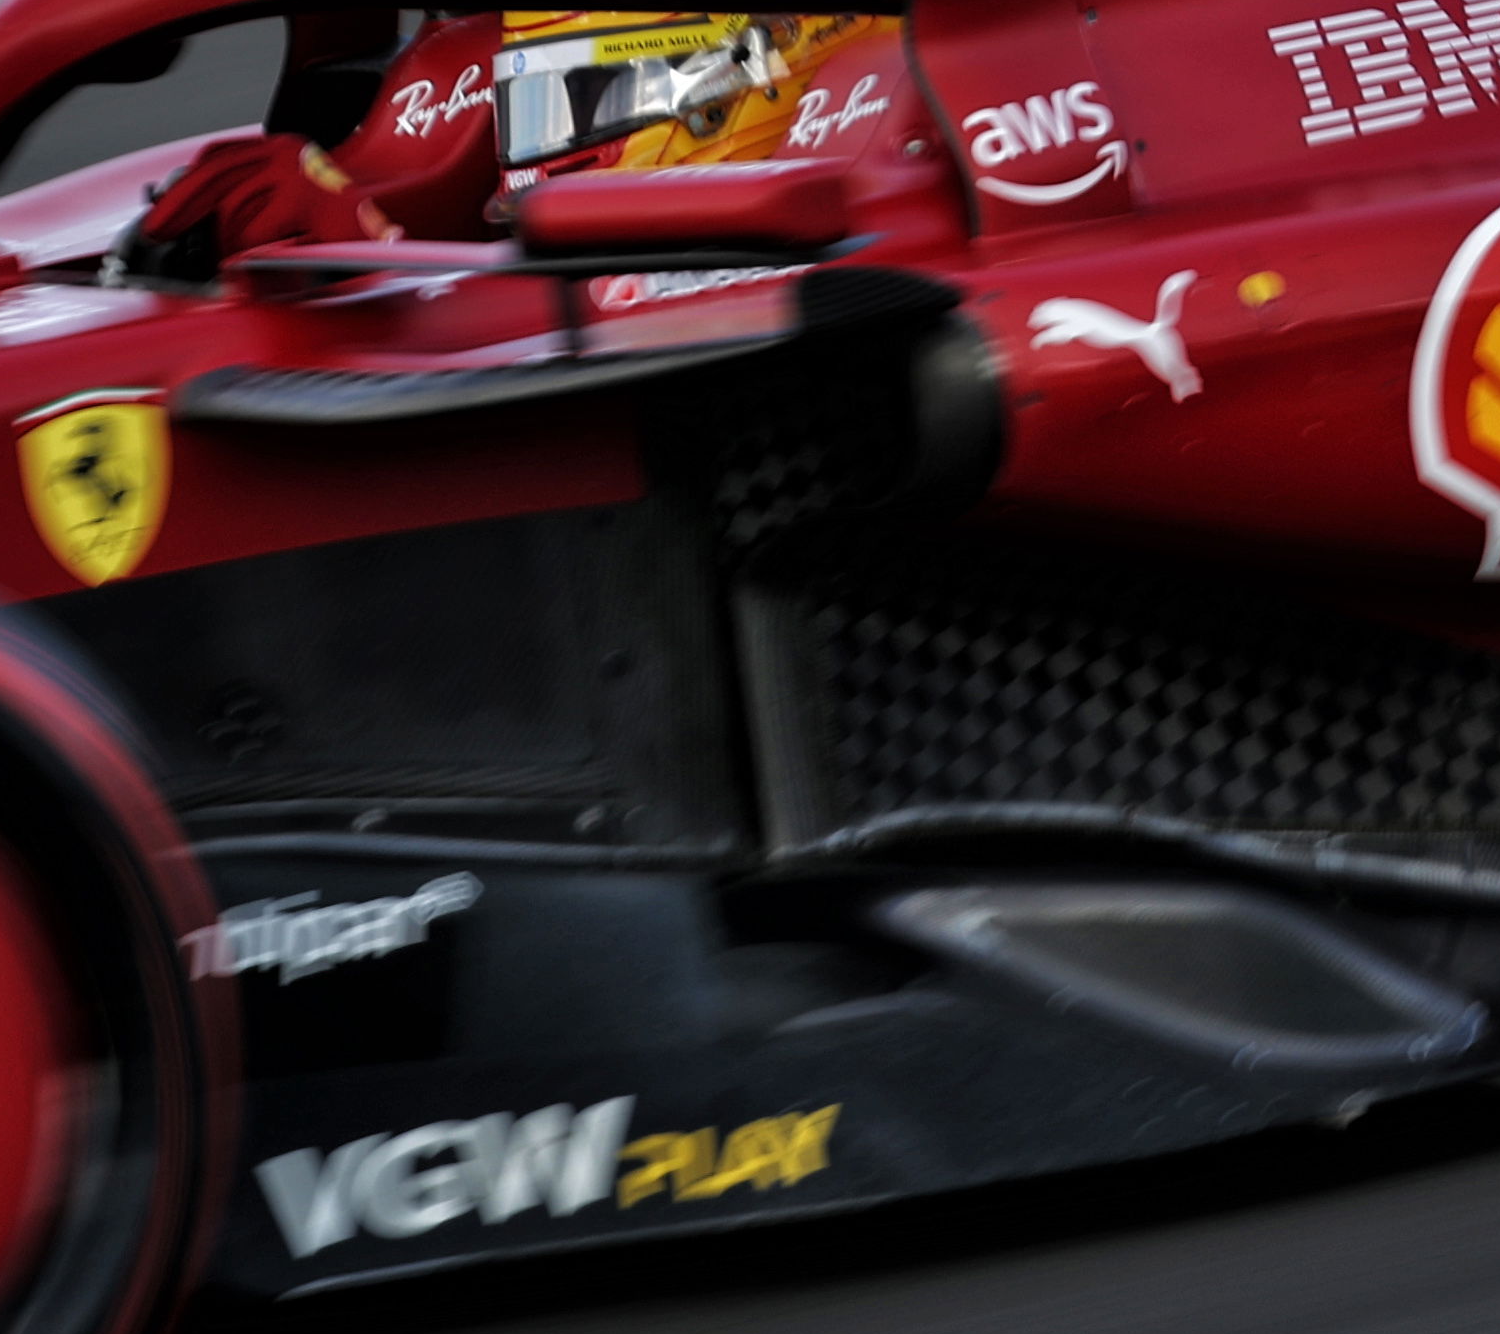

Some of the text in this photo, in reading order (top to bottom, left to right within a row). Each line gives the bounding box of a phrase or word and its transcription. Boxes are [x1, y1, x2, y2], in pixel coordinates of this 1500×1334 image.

[603, 38, 664, 54] RICHARD
[962, 79, 1114, 170] aws
[253, 1094, 637, 1259] VGW
